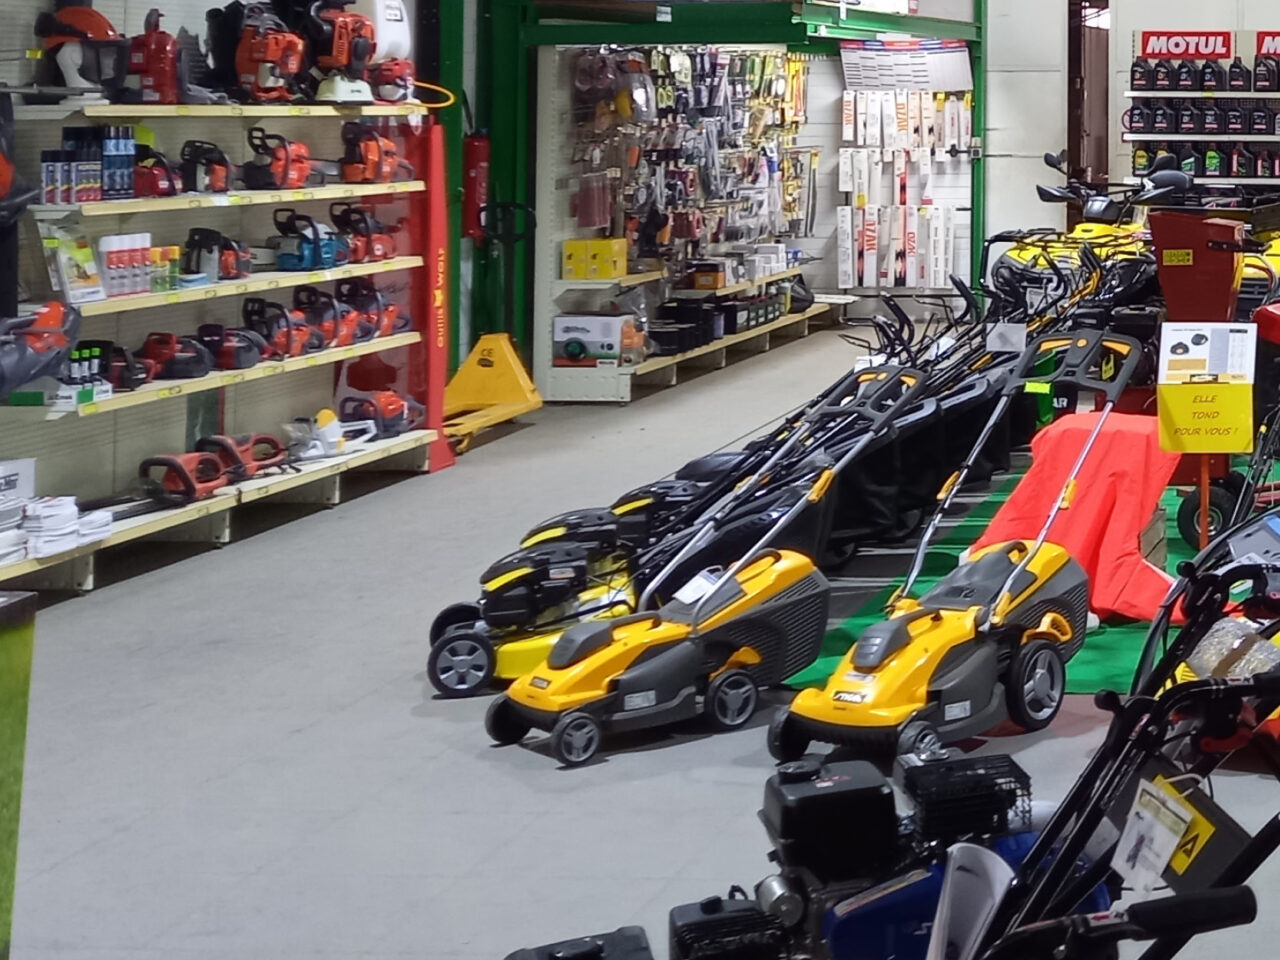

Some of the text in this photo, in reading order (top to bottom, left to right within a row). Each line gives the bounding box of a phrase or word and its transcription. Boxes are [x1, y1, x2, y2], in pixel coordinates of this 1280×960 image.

[1145, 35, 1228, 55] MOTUL
[1192, 394, 1218, 404] ELLE
[1192, 411, 1220, 420] TOND
[1174, 427, 1201, 436] POUR
[1204, 427, 1232, 436] VOUS
